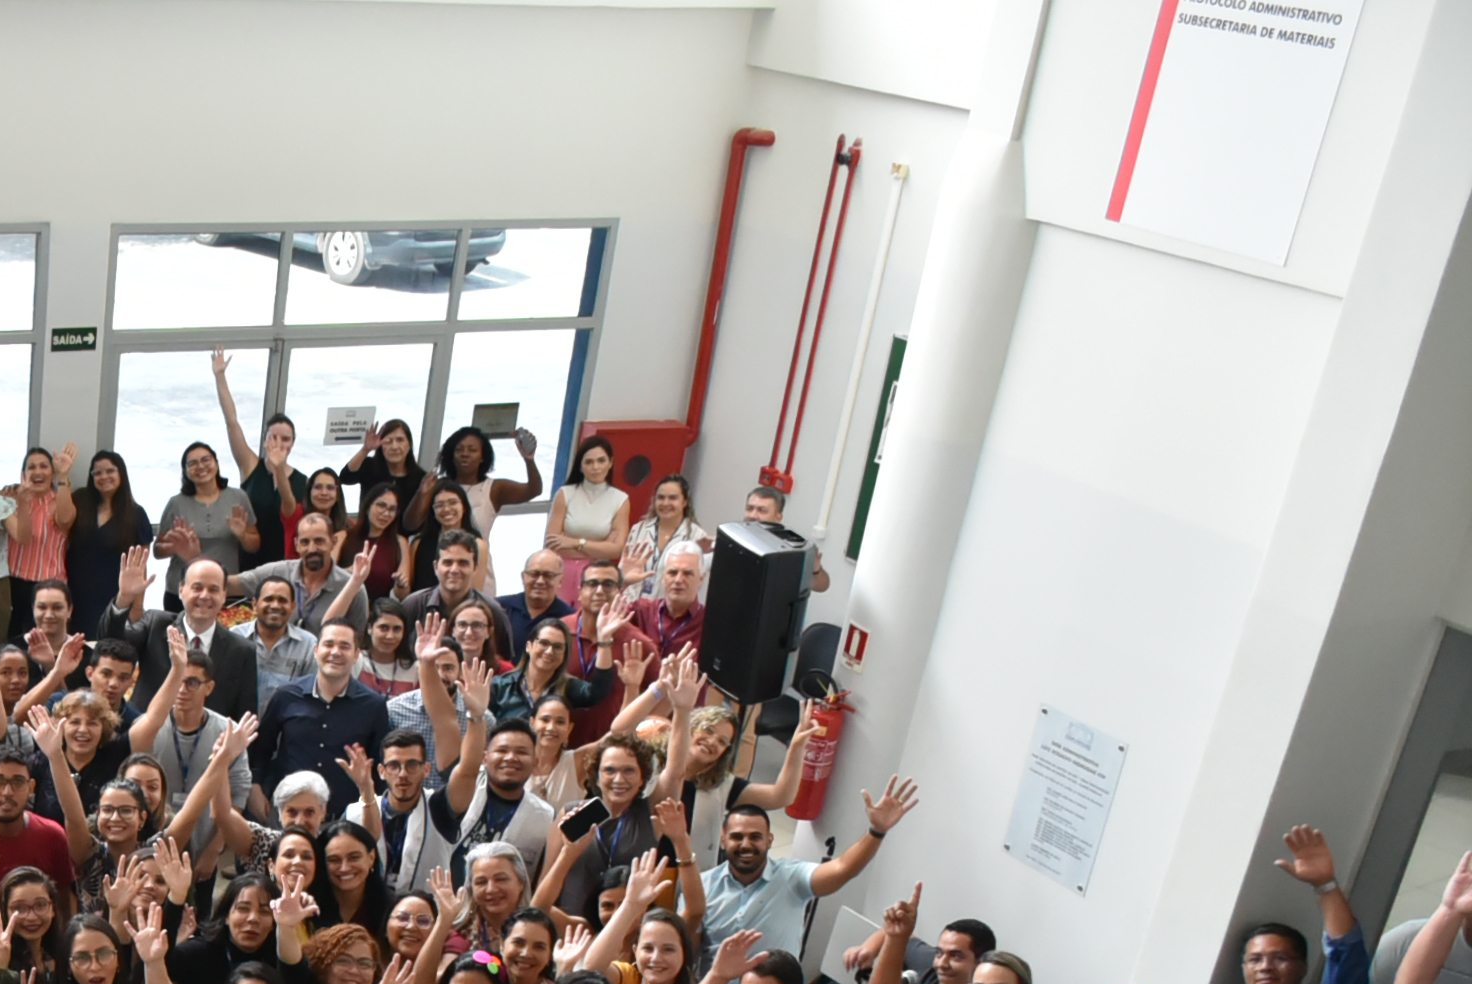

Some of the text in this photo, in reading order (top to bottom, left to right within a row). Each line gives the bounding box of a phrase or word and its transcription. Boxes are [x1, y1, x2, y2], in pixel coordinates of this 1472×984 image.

[1248, 1, 1343, 26] ADMINISTRATIVO
[1177, 12, 1336, 50] SUBSECRETARIA DE MATERIAIS
[52, 333, 83, 346] SAÍDA
